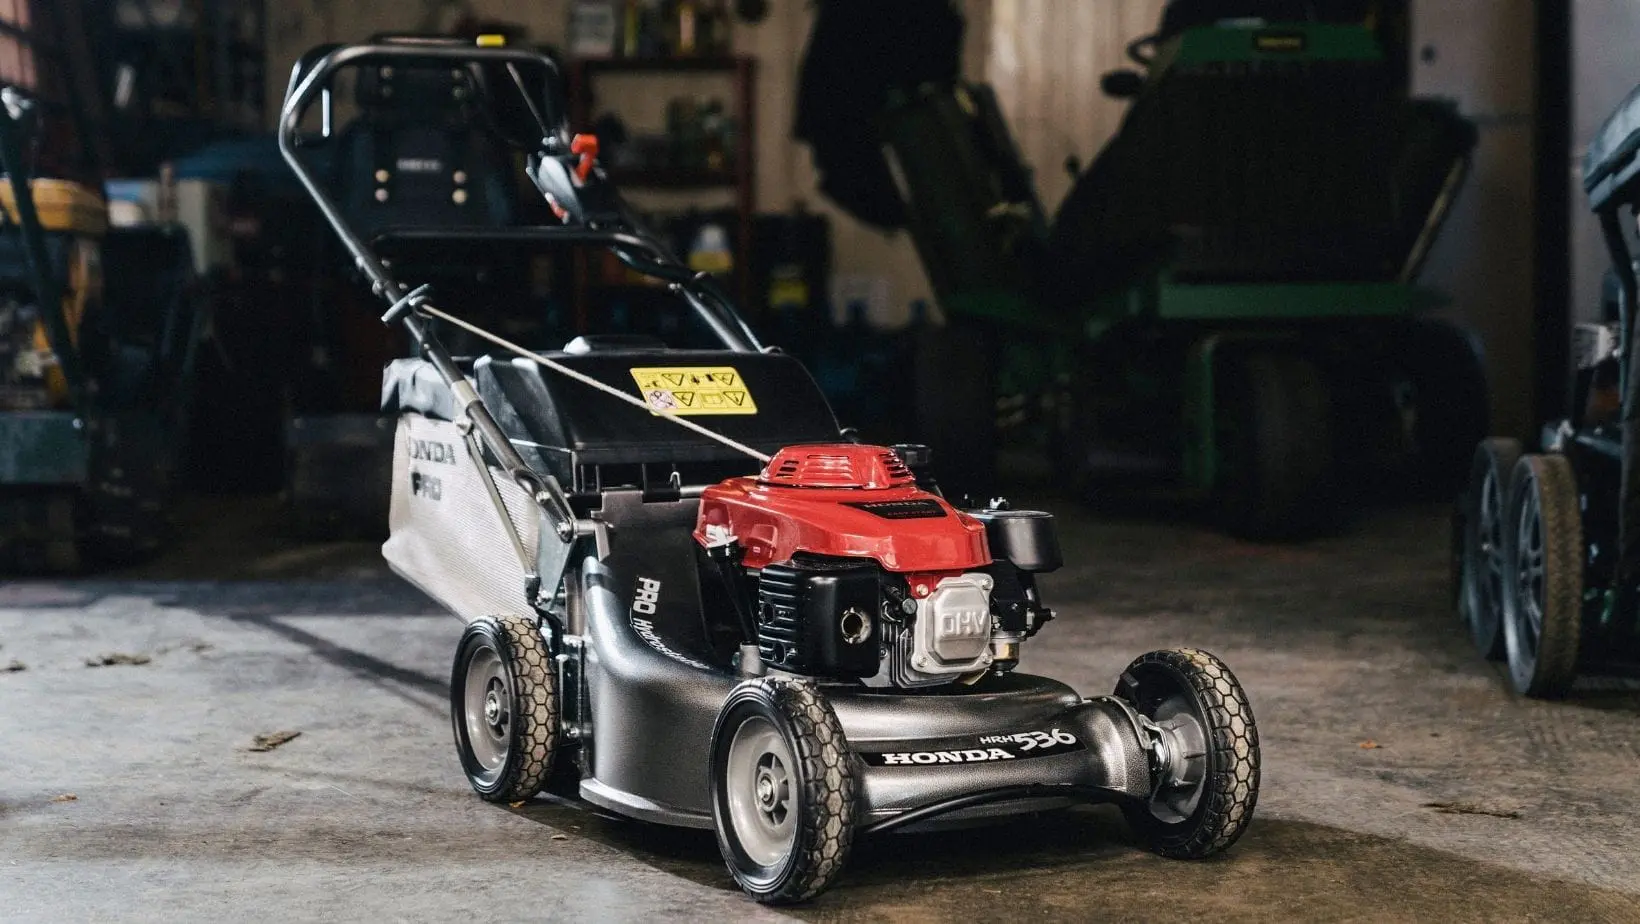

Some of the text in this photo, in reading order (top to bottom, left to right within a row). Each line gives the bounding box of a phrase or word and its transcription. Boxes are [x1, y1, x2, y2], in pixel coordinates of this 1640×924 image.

[633, 577, 661, 615] PRO
[939, 610, 987, 636] OHV
[980, 728, 1077, 751] HRH 536
[882, 748, 1016, 765] HONDA
